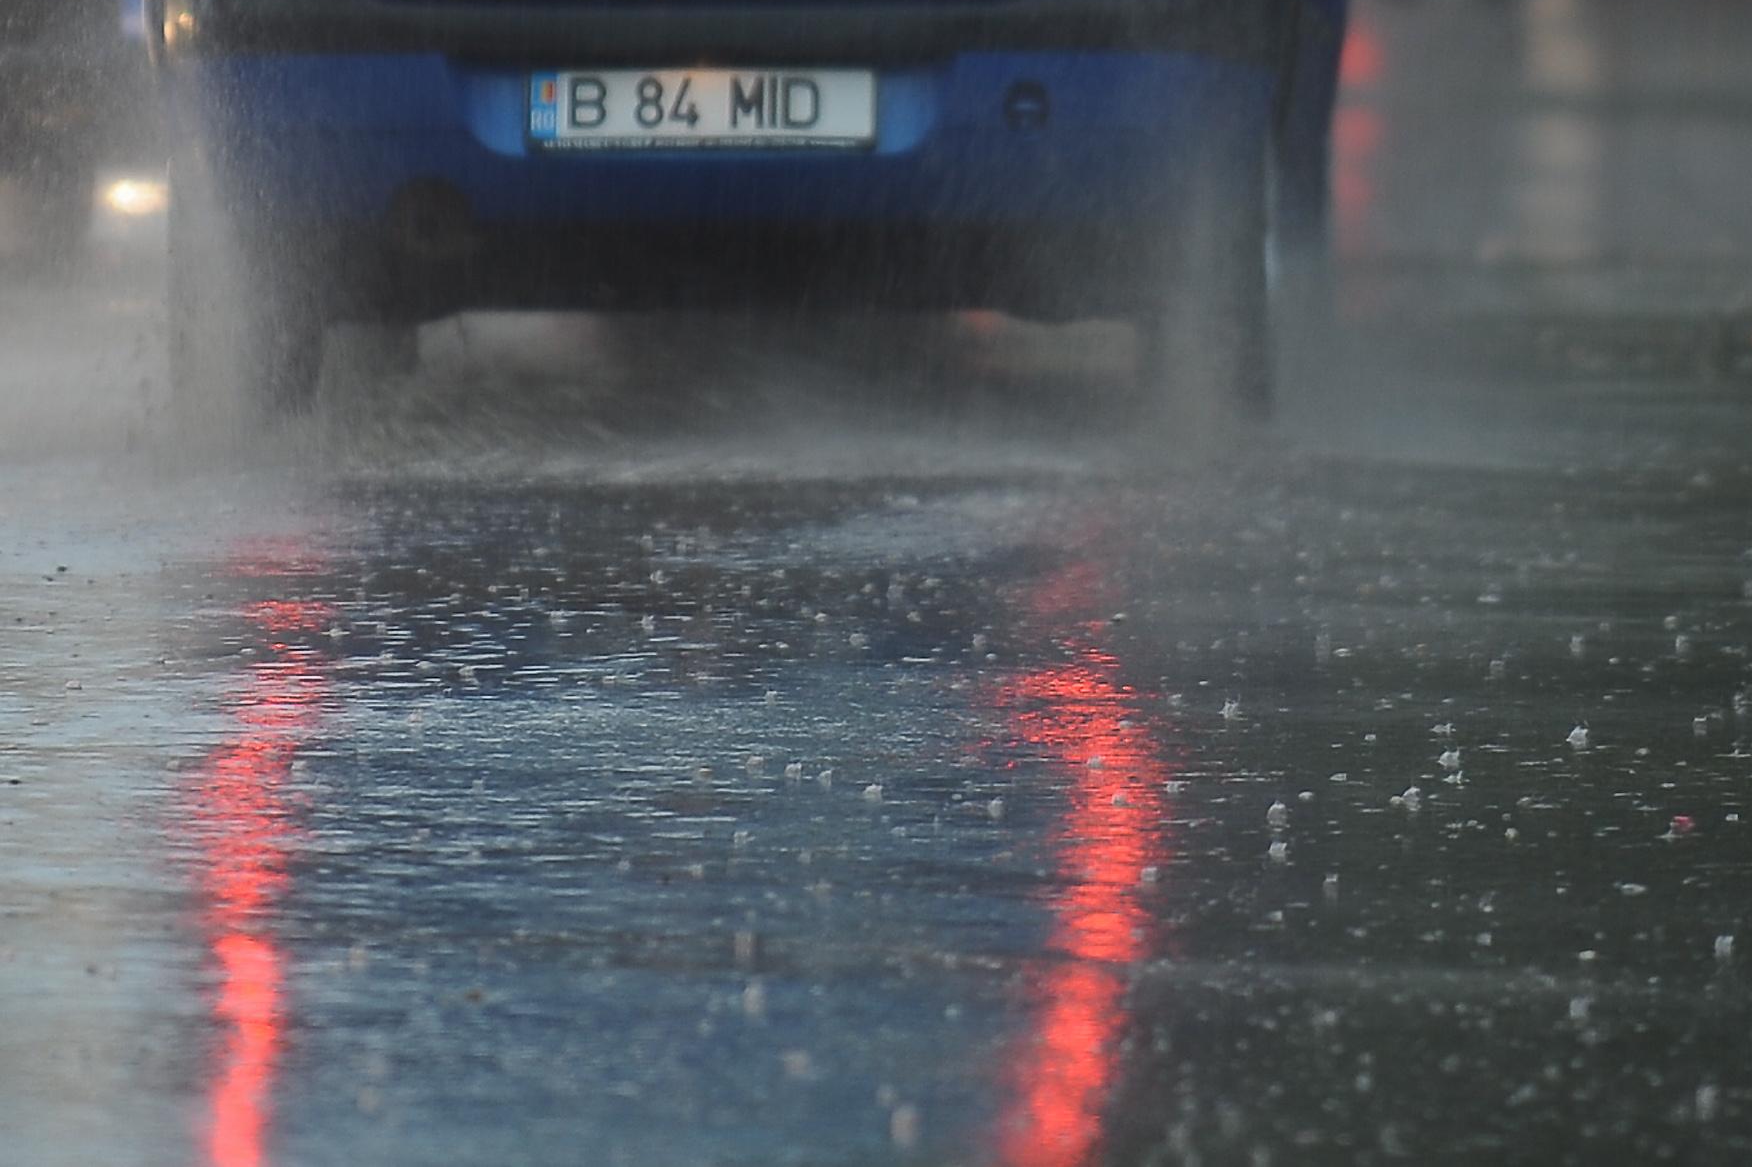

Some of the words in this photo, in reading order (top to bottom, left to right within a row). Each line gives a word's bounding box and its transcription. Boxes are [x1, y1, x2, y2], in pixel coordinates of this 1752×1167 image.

[569, 77, 608, 130] B
[635, 77, 699, 130] 84
[729, 77, 820, 130] MID
